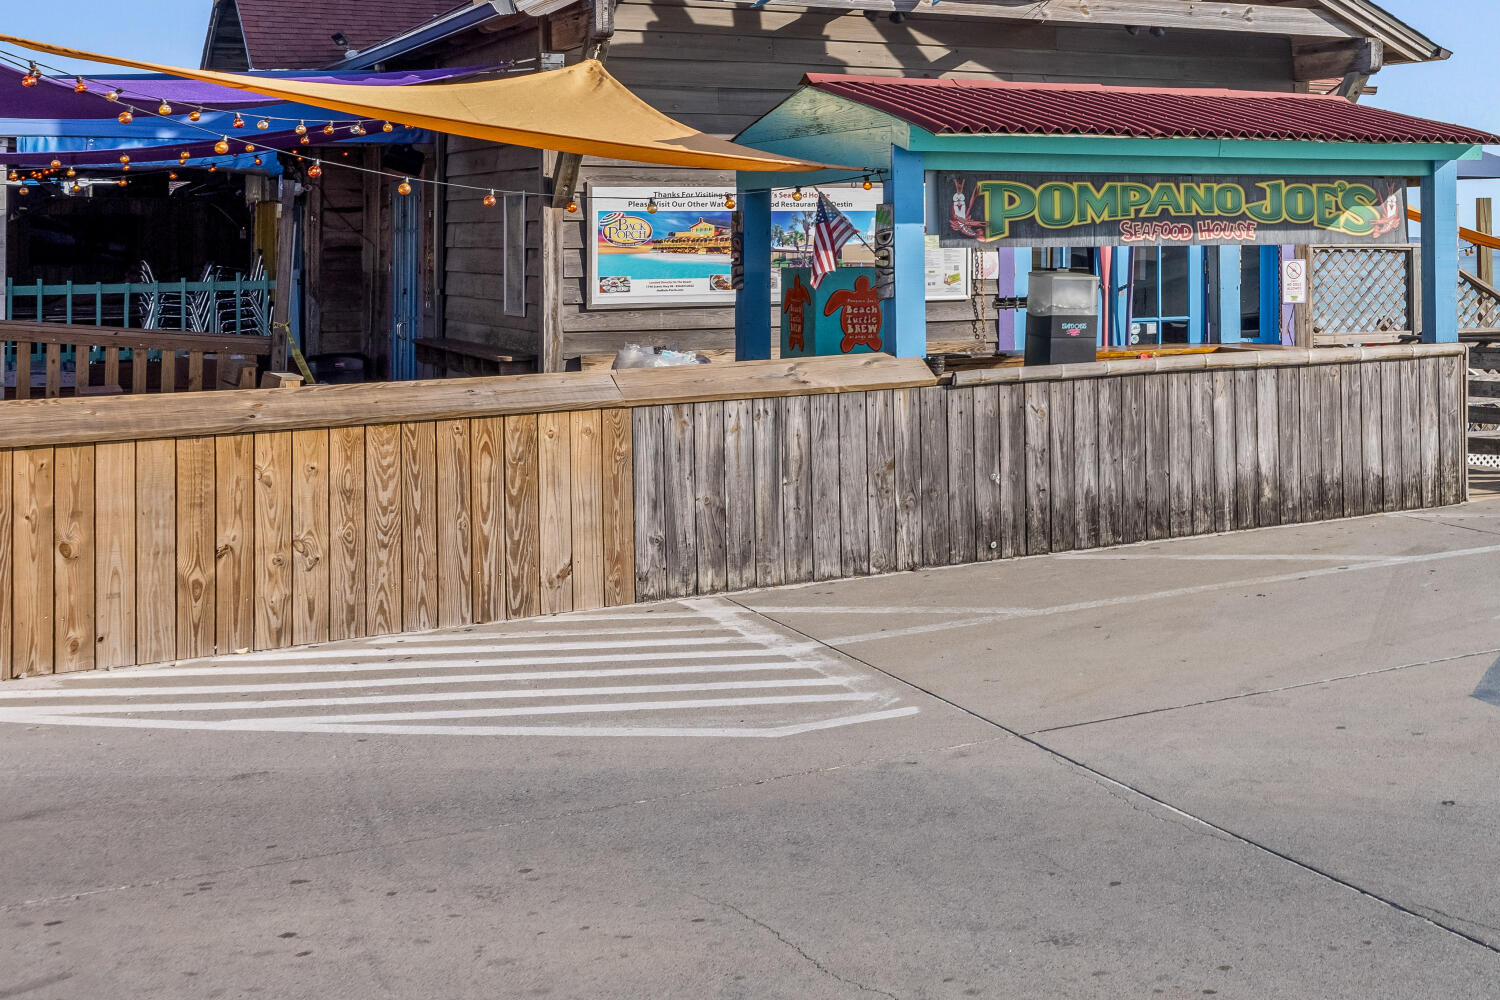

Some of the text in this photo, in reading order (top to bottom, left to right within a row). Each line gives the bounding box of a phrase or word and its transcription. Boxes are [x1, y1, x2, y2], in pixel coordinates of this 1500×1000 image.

[653, 191, 680, 199] Thanks
[695, 191, 723, 200] Visiting
[687, 200, 708, 208] Other
[977, 179, 1381, 242] POMPANO JOE'S
[618, 218, 647, 231] BACK
[608, 226, 647, 239] PORCH
[1119, 219, 1257, 242] SEAFOOD HOUSE
[846, 305, 878, 314] Beach
[846, 314, 877, 324] Turtle
[847, 324, 878, 334] BREW
